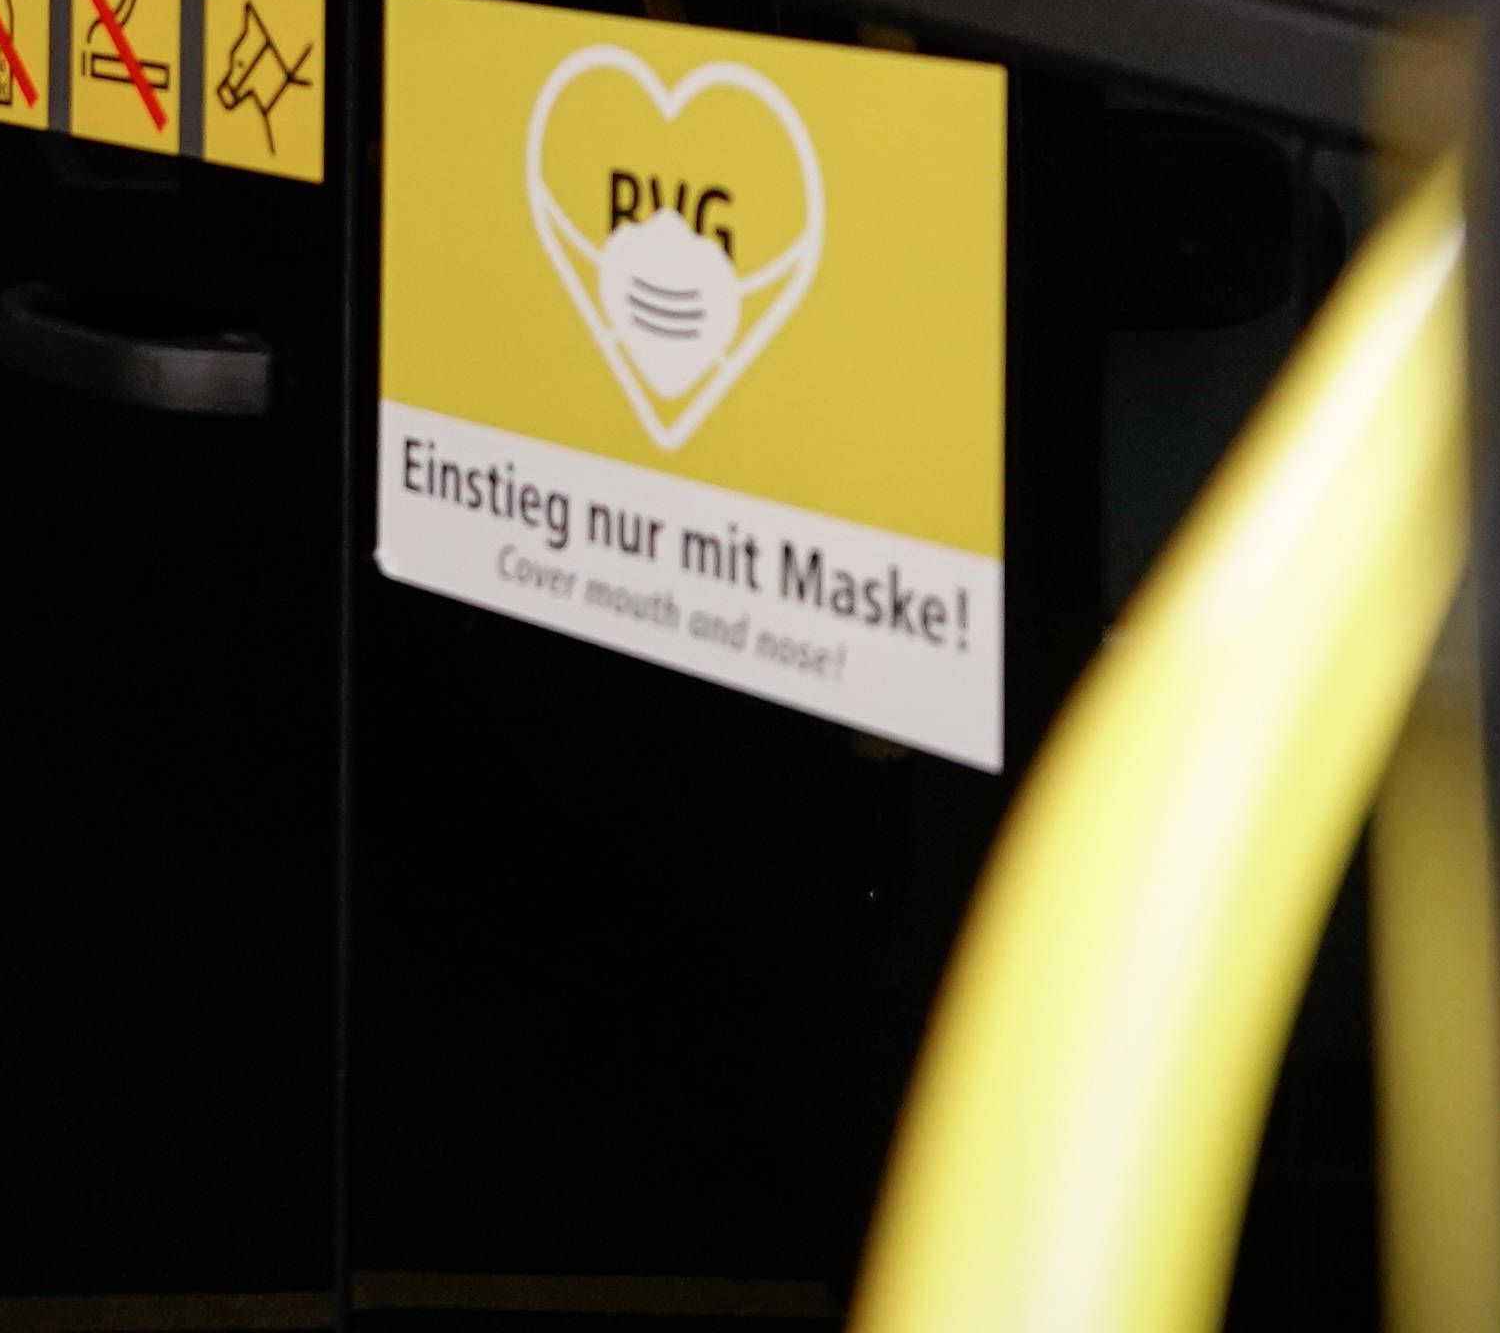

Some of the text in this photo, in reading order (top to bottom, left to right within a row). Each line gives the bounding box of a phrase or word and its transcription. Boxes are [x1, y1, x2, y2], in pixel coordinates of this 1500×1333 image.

[402, 435, 969, 654] Einstieg nur mit Maske!
[498, 543, 848, 683] Cover mouth and nose!
